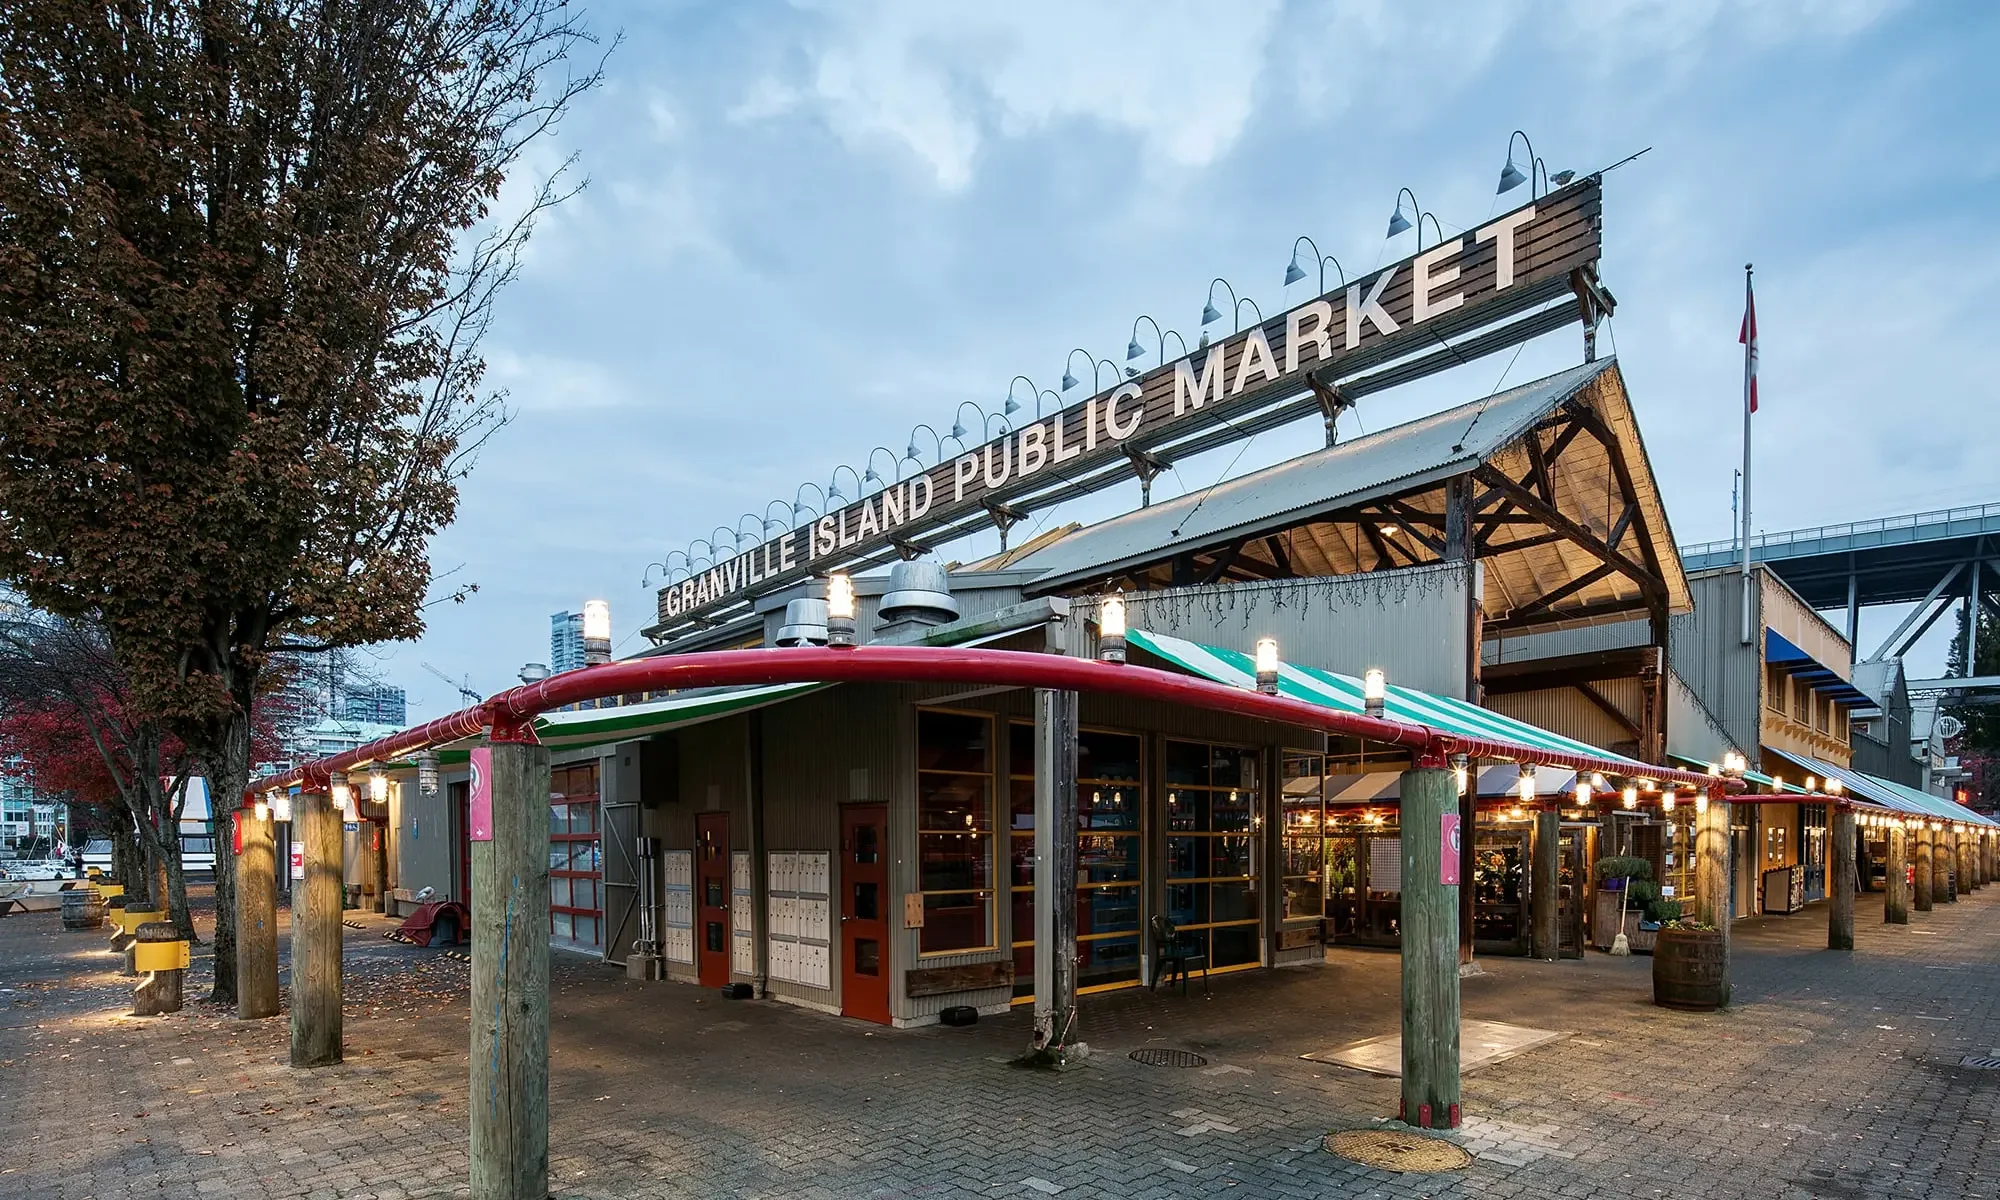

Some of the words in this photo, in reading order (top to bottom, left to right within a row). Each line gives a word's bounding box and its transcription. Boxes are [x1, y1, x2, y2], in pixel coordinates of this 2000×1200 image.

[667, 532, 796, 617] GRANVILLE
[809, 474, 933, 561] ISLAND
[955, 382, 1143, 503] PUBLIC
[1173, 205, 1536, 418] MARKET
